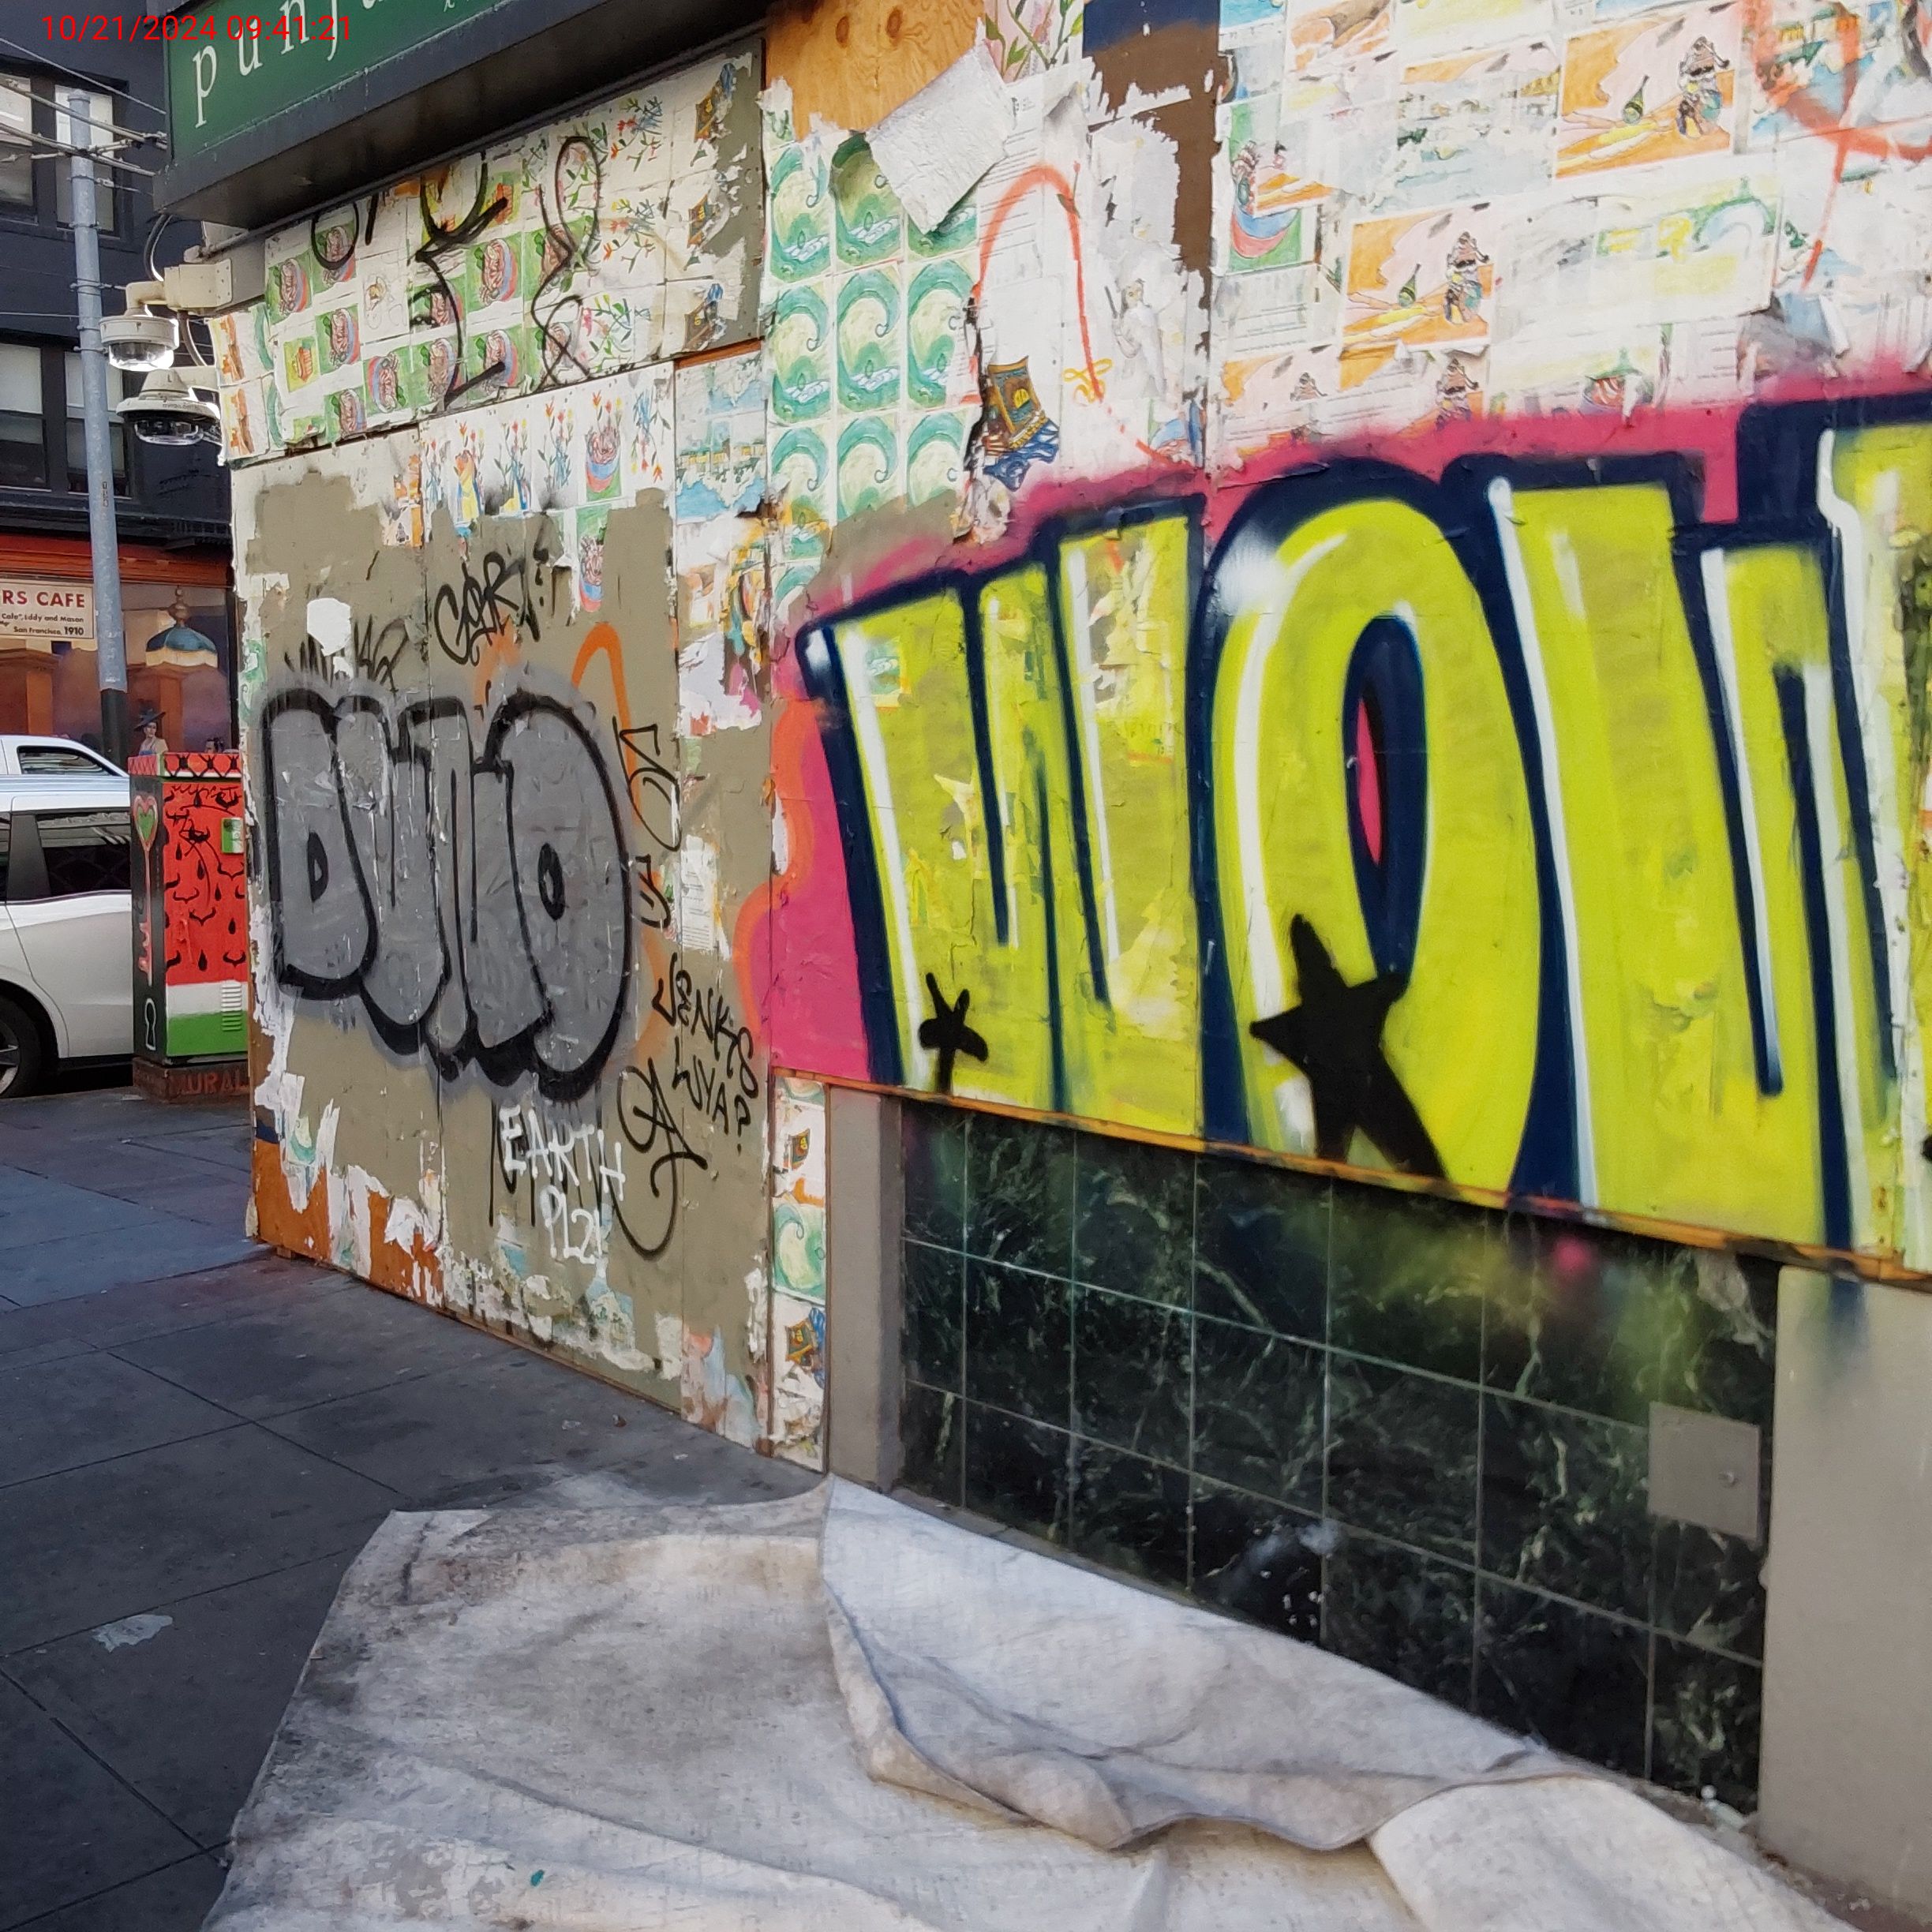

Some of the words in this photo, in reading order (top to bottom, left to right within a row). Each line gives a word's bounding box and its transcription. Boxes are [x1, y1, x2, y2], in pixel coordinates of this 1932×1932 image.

[193, 0, 384, 128] punj
[36, 591, 84, 608] CAFE
[64, 626, 84, 635] 1910
[499, 1105, 626, 1202] EARTH
